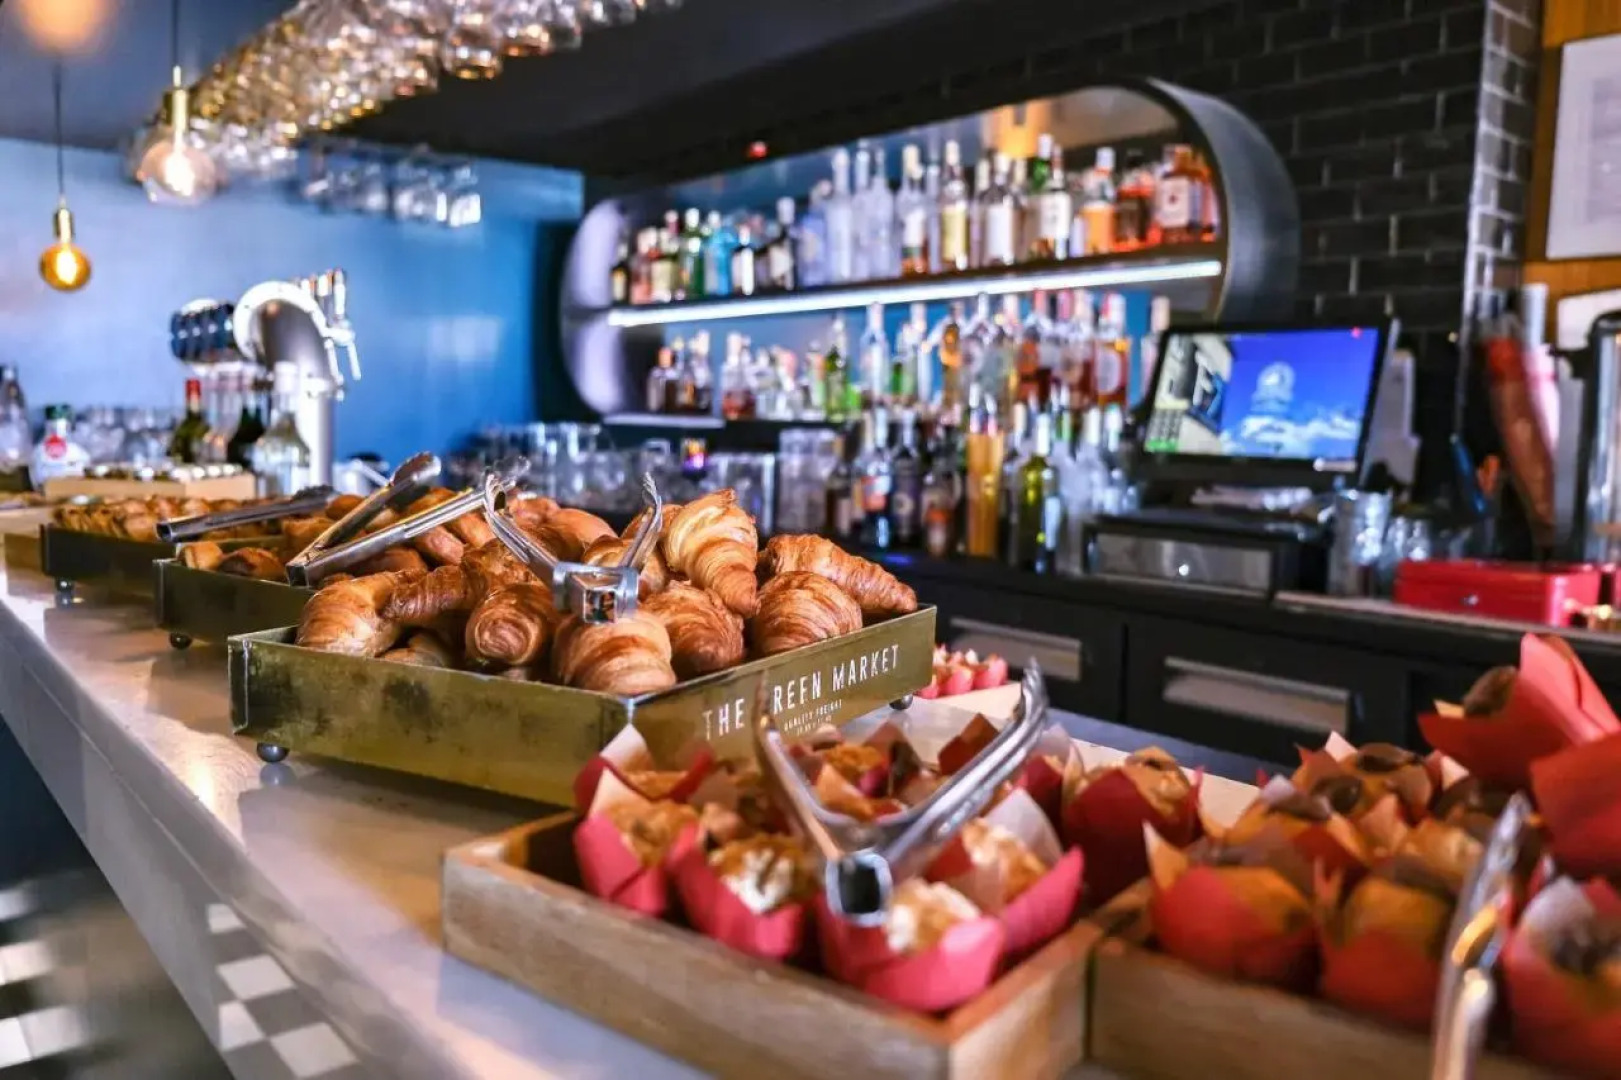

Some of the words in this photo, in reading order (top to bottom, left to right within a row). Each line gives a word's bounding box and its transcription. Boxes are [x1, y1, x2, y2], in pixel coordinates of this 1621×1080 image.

[702, 698, 745, 740] THE
[764, 671, 821, 716] REEN
[832, 644, 899, 691] MARKET
